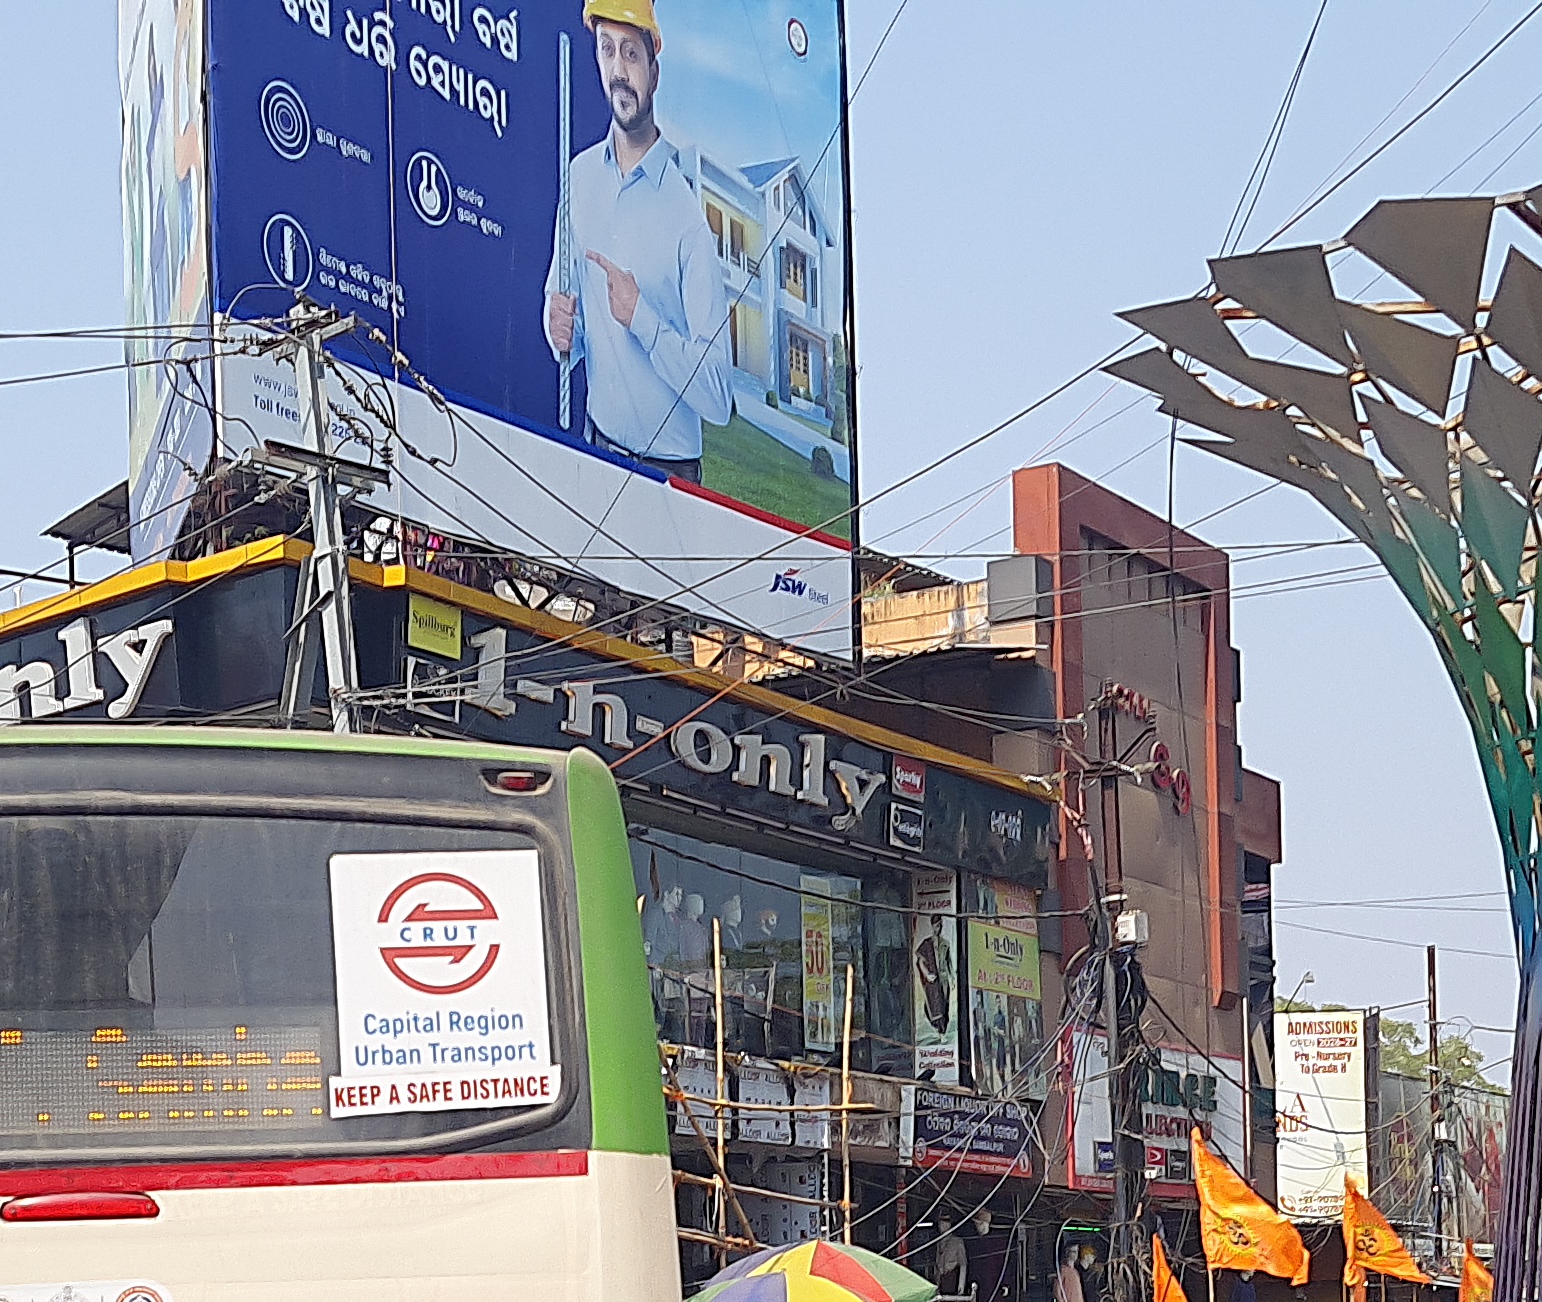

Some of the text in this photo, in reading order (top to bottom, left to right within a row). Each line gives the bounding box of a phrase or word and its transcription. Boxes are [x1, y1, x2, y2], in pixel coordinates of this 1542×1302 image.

[254, 394, 273, 413] Toll
[399, 924, 479, 943] CRUT
[363, 1010, 524, 1039] Capital Region
[1287, 1021, 1358, 1036] ADMISSIONS
[354, 1040, 536, 1068] Urban Transport
[334, 1075, 551, 1108] KEEP A SAFE DISTANCE
